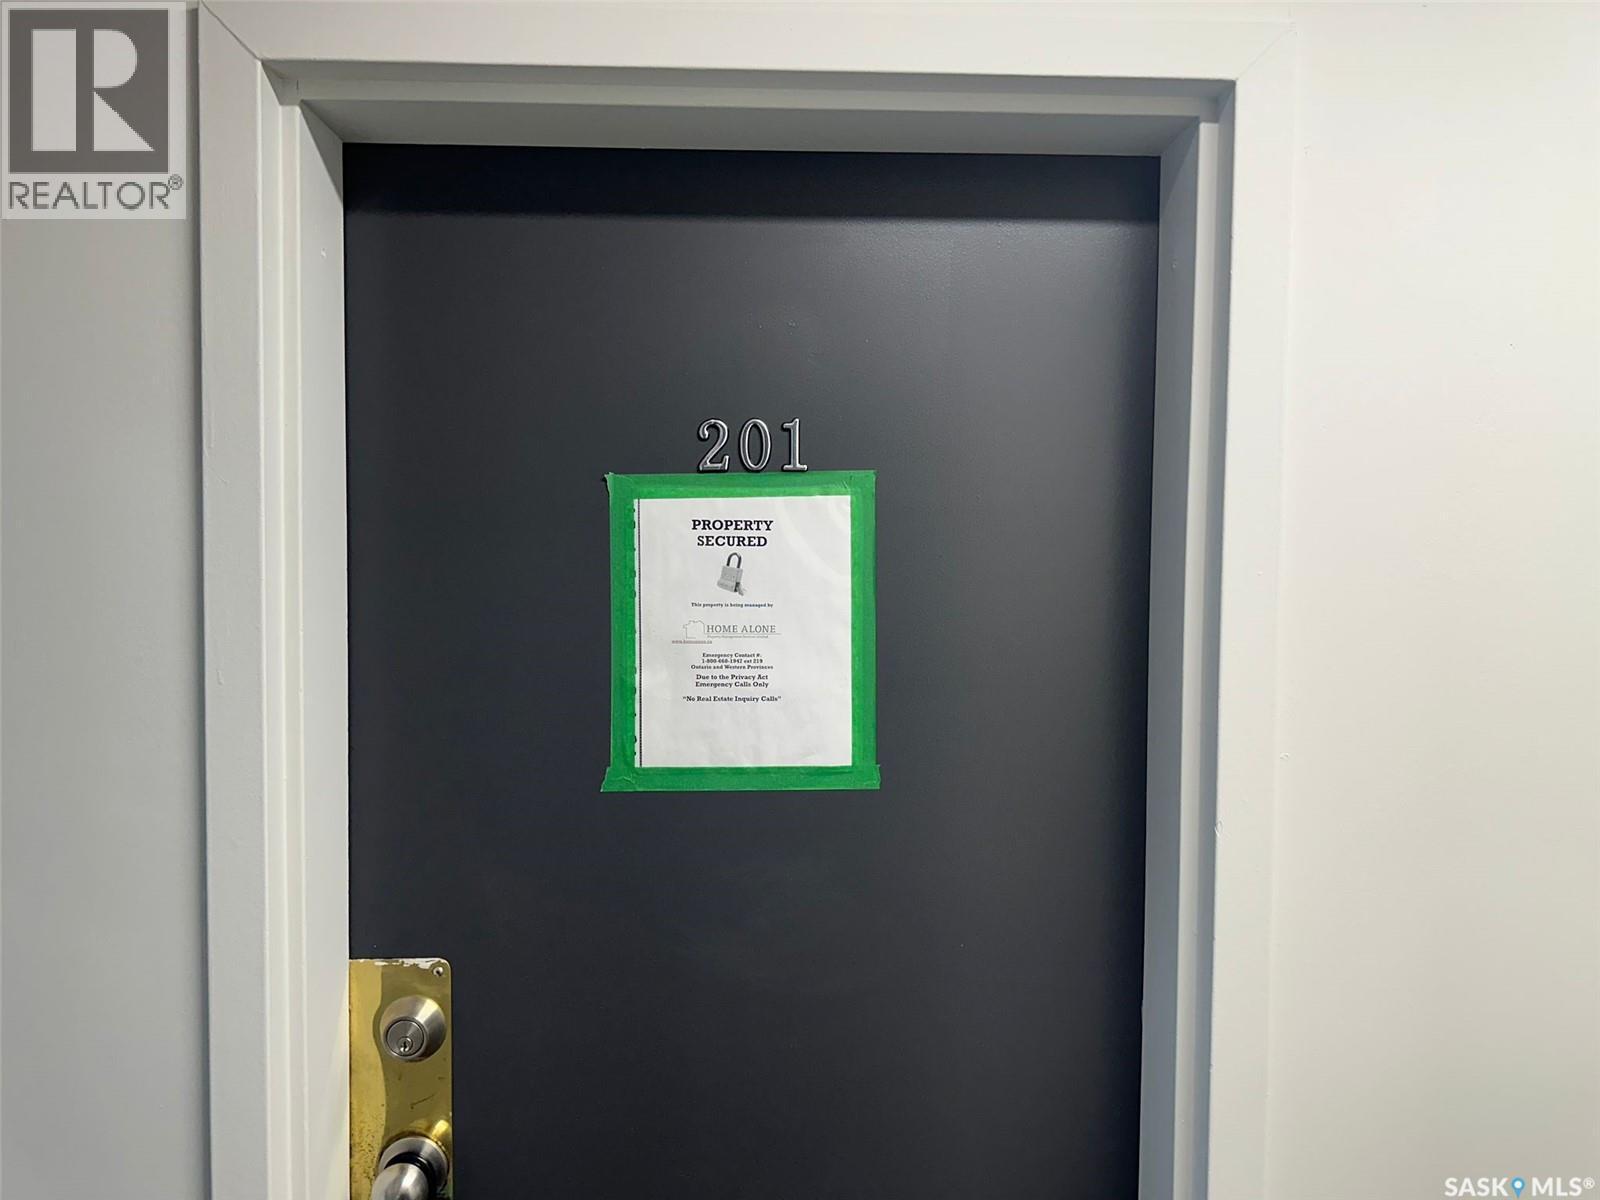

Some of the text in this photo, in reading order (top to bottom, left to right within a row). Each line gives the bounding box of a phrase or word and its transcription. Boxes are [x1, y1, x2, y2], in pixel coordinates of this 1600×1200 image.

[697, 417, 808, 473] 201
[691, 518, 774, 531] PROPERTY
[697, 534, 768, 547] SECURED
[706, 624, 777, 633] HOME ALONE
[695, 681, 733, 689] Emergency
[753, 681, 769, 689] Only
